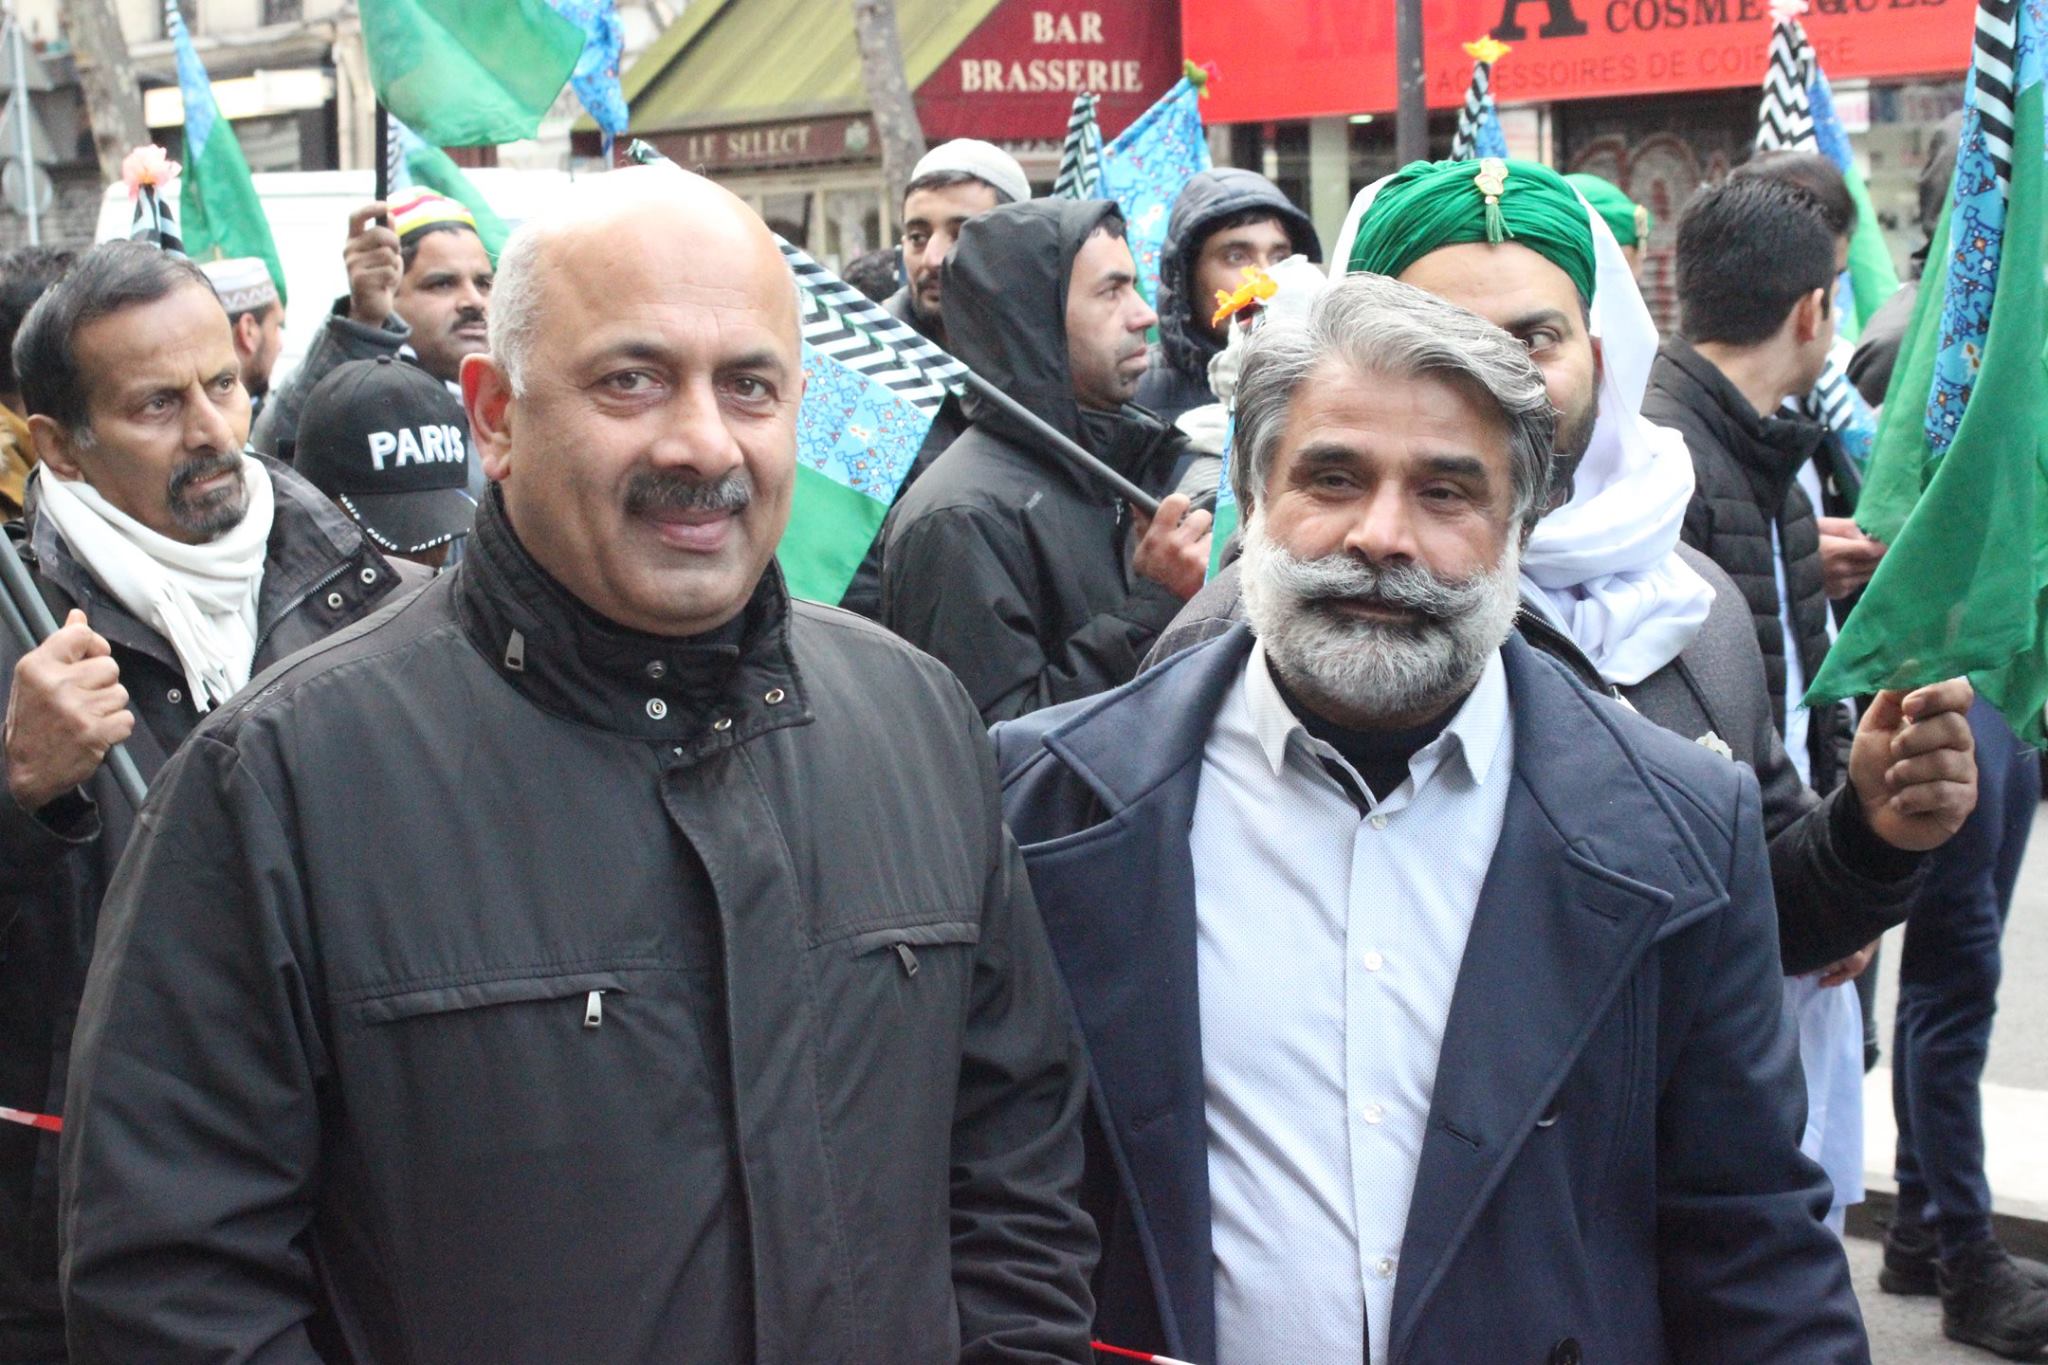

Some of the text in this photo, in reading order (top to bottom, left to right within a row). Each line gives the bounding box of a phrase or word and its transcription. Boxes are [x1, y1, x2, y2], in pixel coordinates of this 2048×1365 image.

[1033, 11, 1104, 44] BAR
[960, 59, 1143, 93] BRASSERIE
[1436, 36, 1856, 94] ACESSOIRES DE COIFRE
[688, 125, 812, 162] LE SELECT
[367, 424, 465, 471] PARIS
[410, 533, 451, 553] PARIS
